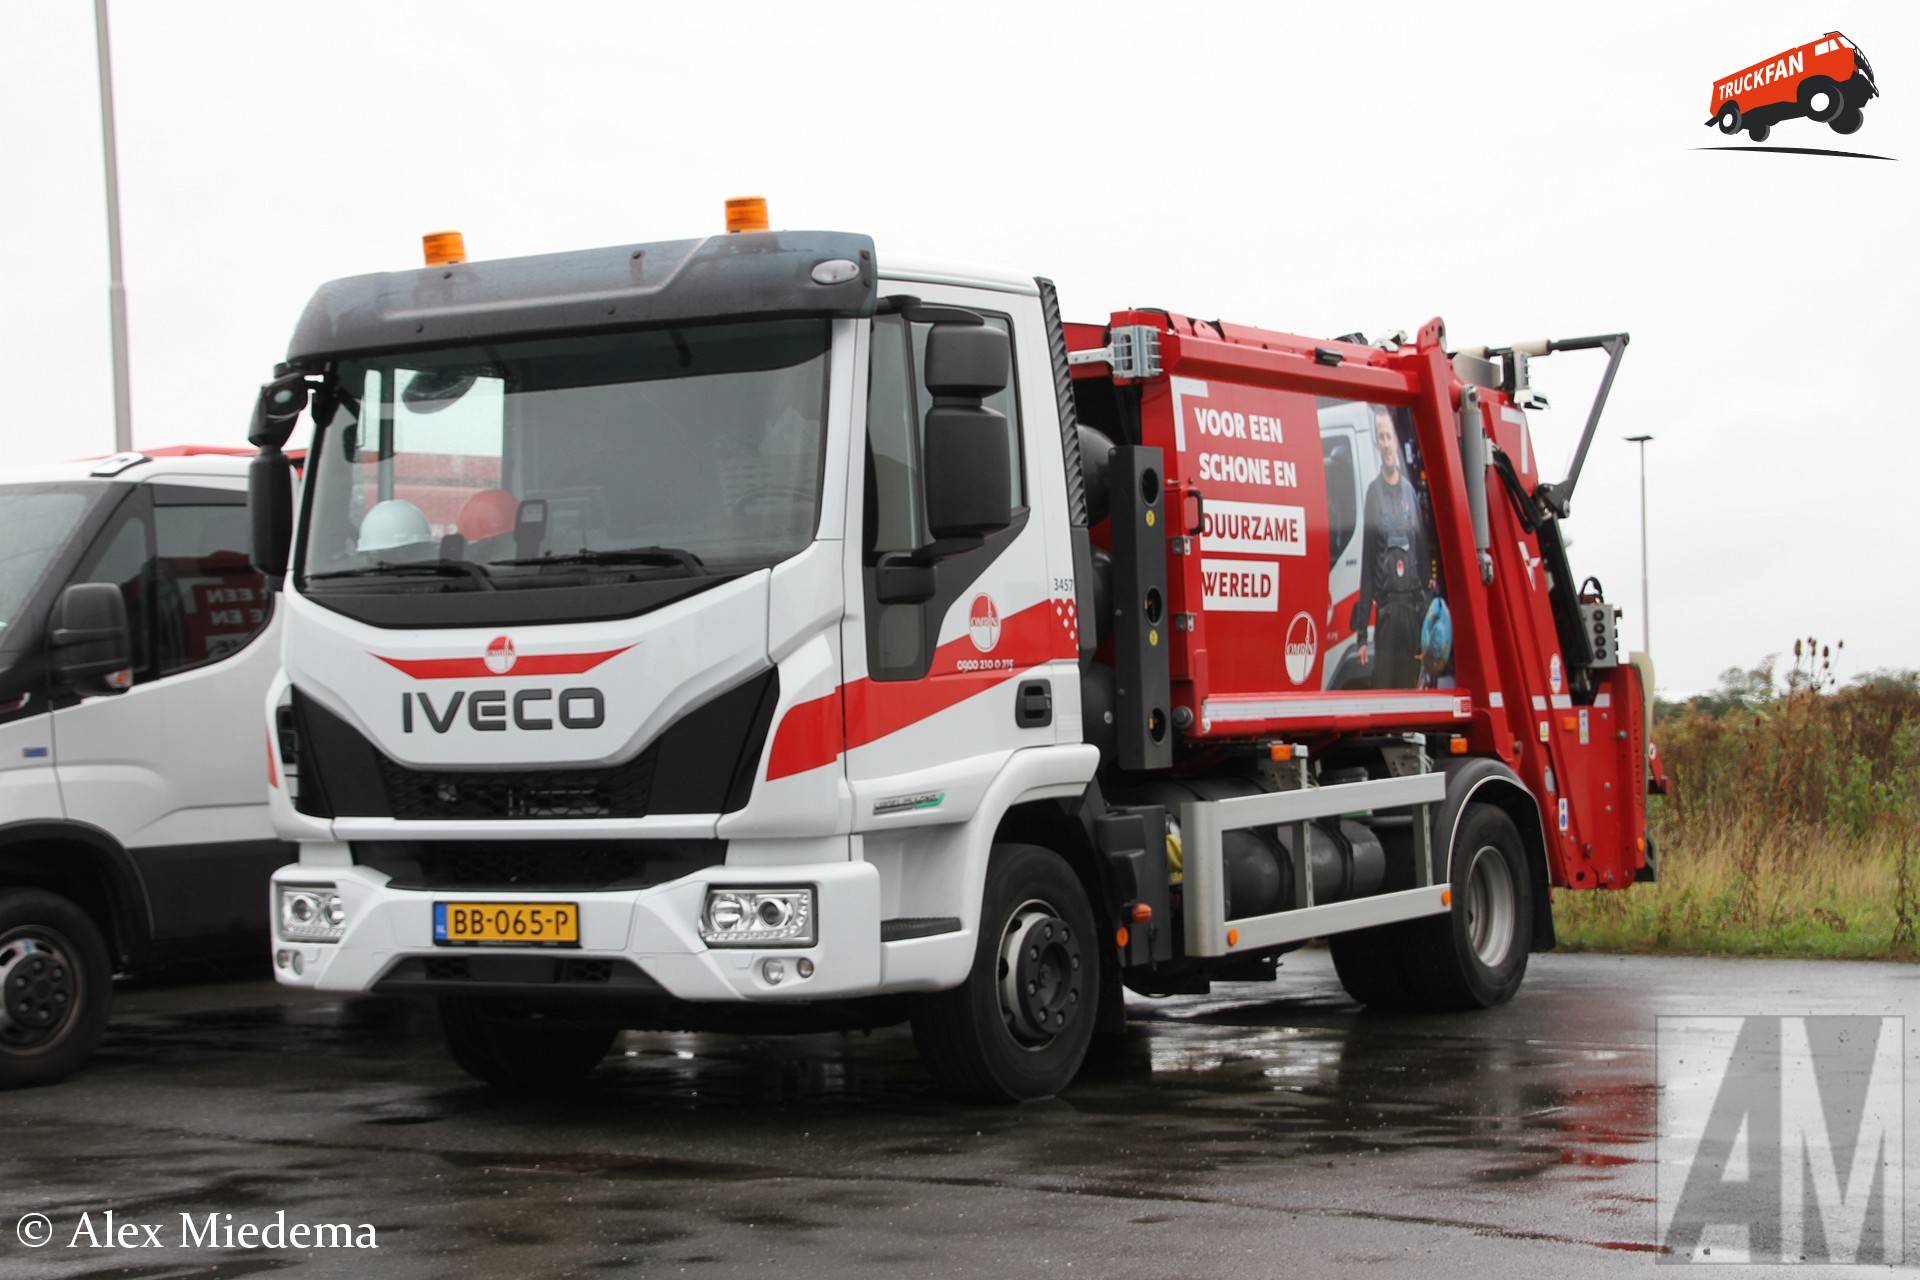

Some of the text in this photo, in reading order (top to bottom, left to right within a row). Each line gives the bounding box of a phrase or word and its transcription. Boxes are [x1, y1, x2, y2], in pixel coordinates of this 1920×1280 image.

[1194, 407, 1283, 444] VOOR EEN
[1199, 453, 1297, 488] SCHONE EN
[1203, 512, 1299, 543] DUURZAME
[1054, 578, 1073, 591] 3457
[1202, 571, 1272, 598] WERELD
[402, 687, 605, 733] IVECO
[454, 909, 568, 936] BB-065-P
